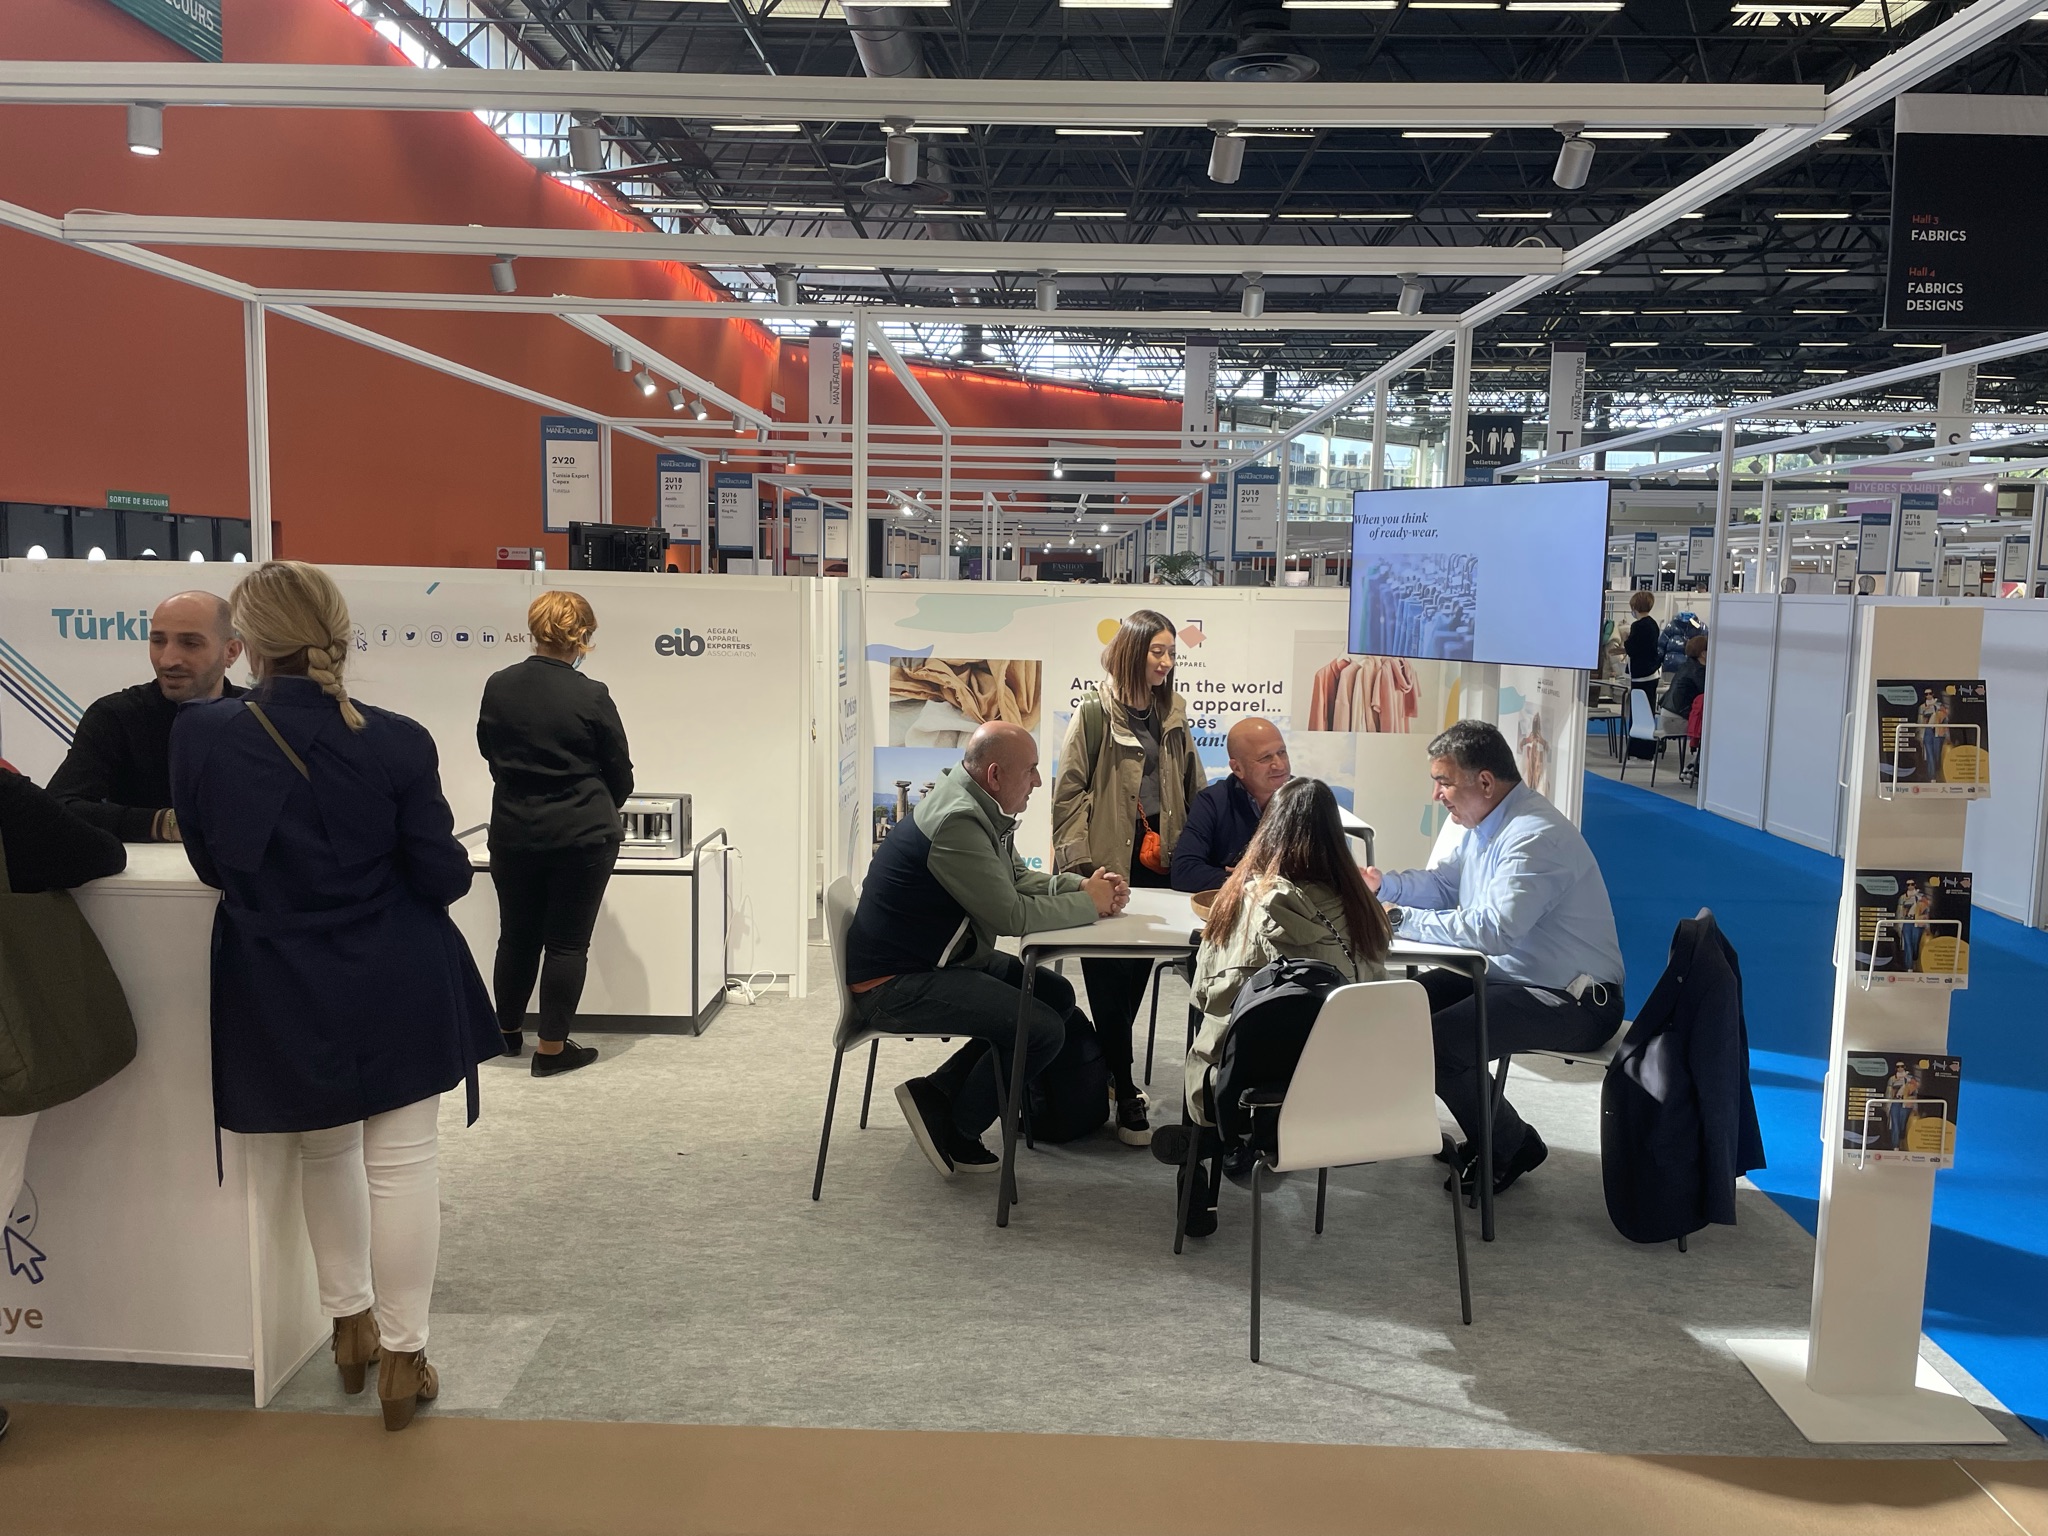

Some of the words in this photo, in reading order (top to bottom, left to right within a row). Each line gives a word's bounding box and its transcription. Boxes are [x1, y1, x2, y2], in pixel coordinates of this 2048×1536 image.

[1912, 214, 1931, 224] Hall
[1911, 229, 1967, 242] FABRICS
[1908, 266, 1928, 277] Hall
[1929, 269, 1936, 277] 4
[1907, 282, 1964, 294] FABRICS
[1906, 299, 1964, 311] DESIGNS
[832, 342, 840, 405] MANUFACTURING
[1207, 351, 1217, 415] MANUFACTURING
[546, 427, 593, 435] MANUFACTURING
[1556, 430, 1574, 452] T
[1948, 432, 1961, 457] S
[552, 456, 575, 465] 2V20
[664, 476, 683, 484] 2U18
[109, 495, 131, 504] SORTIE
[132, 497, 140, 505] DE
[142, 497, 169, 507] SECOURS
[1354, 513, 1380, 525] When
[1380, 515, 1399, 527] you
[1401, 512, 1429, 524] think
[1369, 527, 1381, 541] of
[1380, 526, 1439, 541] ready-wear,
[51, 608, 153, 641] Türki
[504, 632, 525, 643] Ask
[654, 627, 706, 657] eib
[706, 650, 757, 658] ASSOCIATION
[1174, 678, 1190, 693] in
[1196, 679, 1226, 694] the
[1231, 680, 1283, 695] world
[1192, 699, 1282, 715] apparel...
